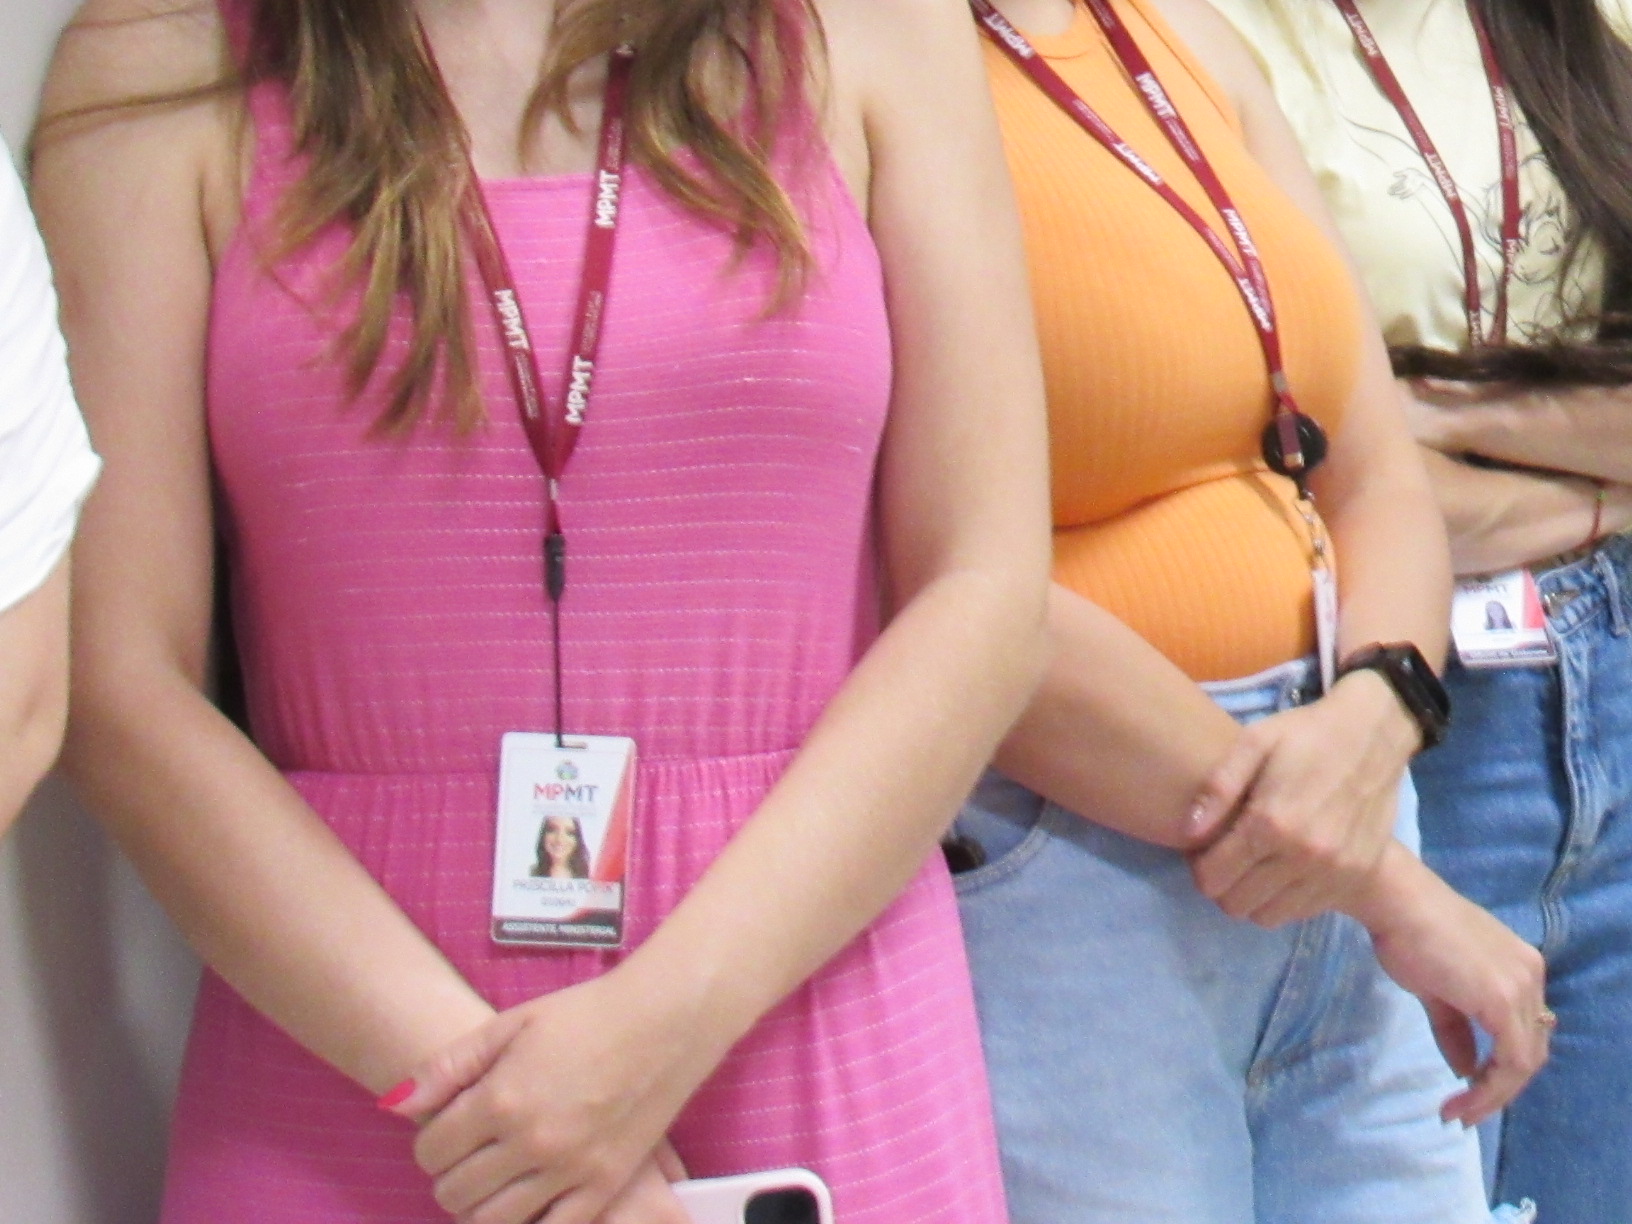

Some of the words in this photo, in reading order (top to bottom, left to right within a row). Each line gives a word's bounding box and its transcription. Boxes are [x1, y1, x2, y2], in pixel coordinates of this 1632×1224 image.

[1136, 72, 1177, 118] MPMT
[596, 171, 620, 227] MPMT
[495, 289, 529, 349] MPMT
[566, 355, 591, 425] MPMT
[534, 783, 598, 802] MPMT
